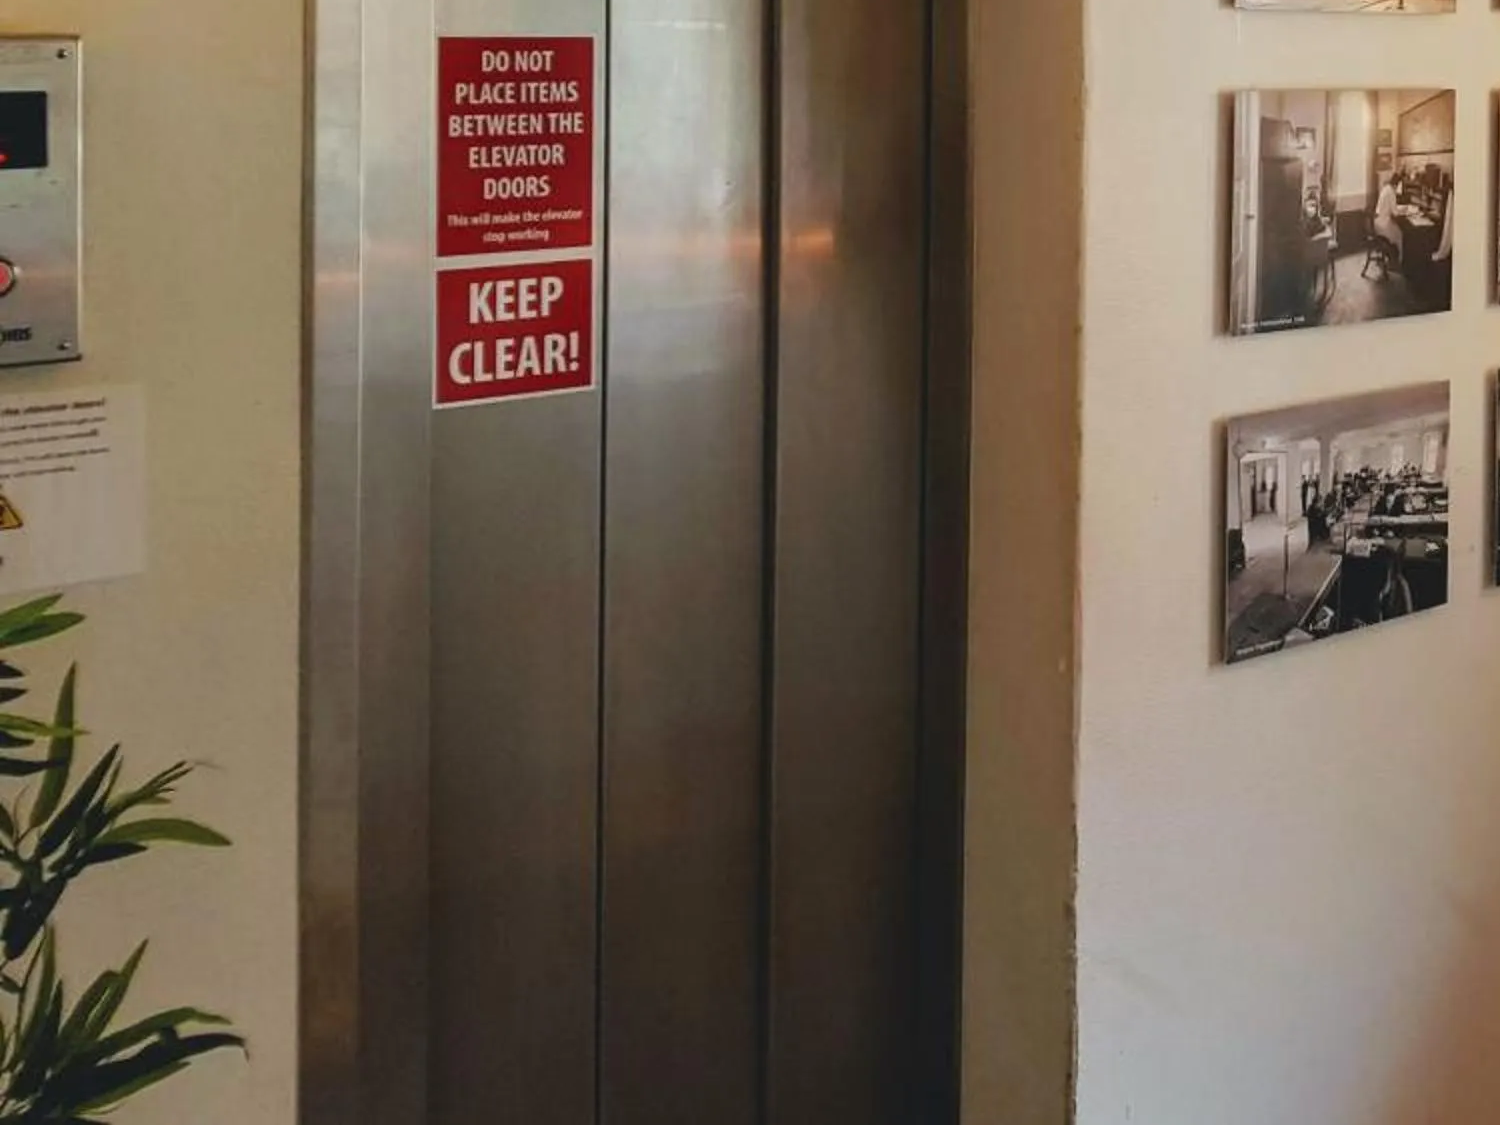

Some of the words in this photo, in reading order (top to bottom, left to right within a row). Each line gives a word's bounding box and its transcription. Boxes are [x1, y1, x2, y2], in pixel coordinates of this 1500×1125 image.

[481, 50, 510, 73] DO
[515, 50, 554, 72] NOT
[455, 81, 515, 105] PLACE
[521, 80, 579, 103] ITEMS
[448, 113, 544, 138] BETWEEN
[549, 111, 585, 134] THE
[468, 143, 565, 169] ELEVATOR
[483, 175, 551, 201] DOORS
[541, 208, 583, 222] elevator
[468, 275, 564, 325] KEEP
[448, 331, 580, 385] CLEAR!
